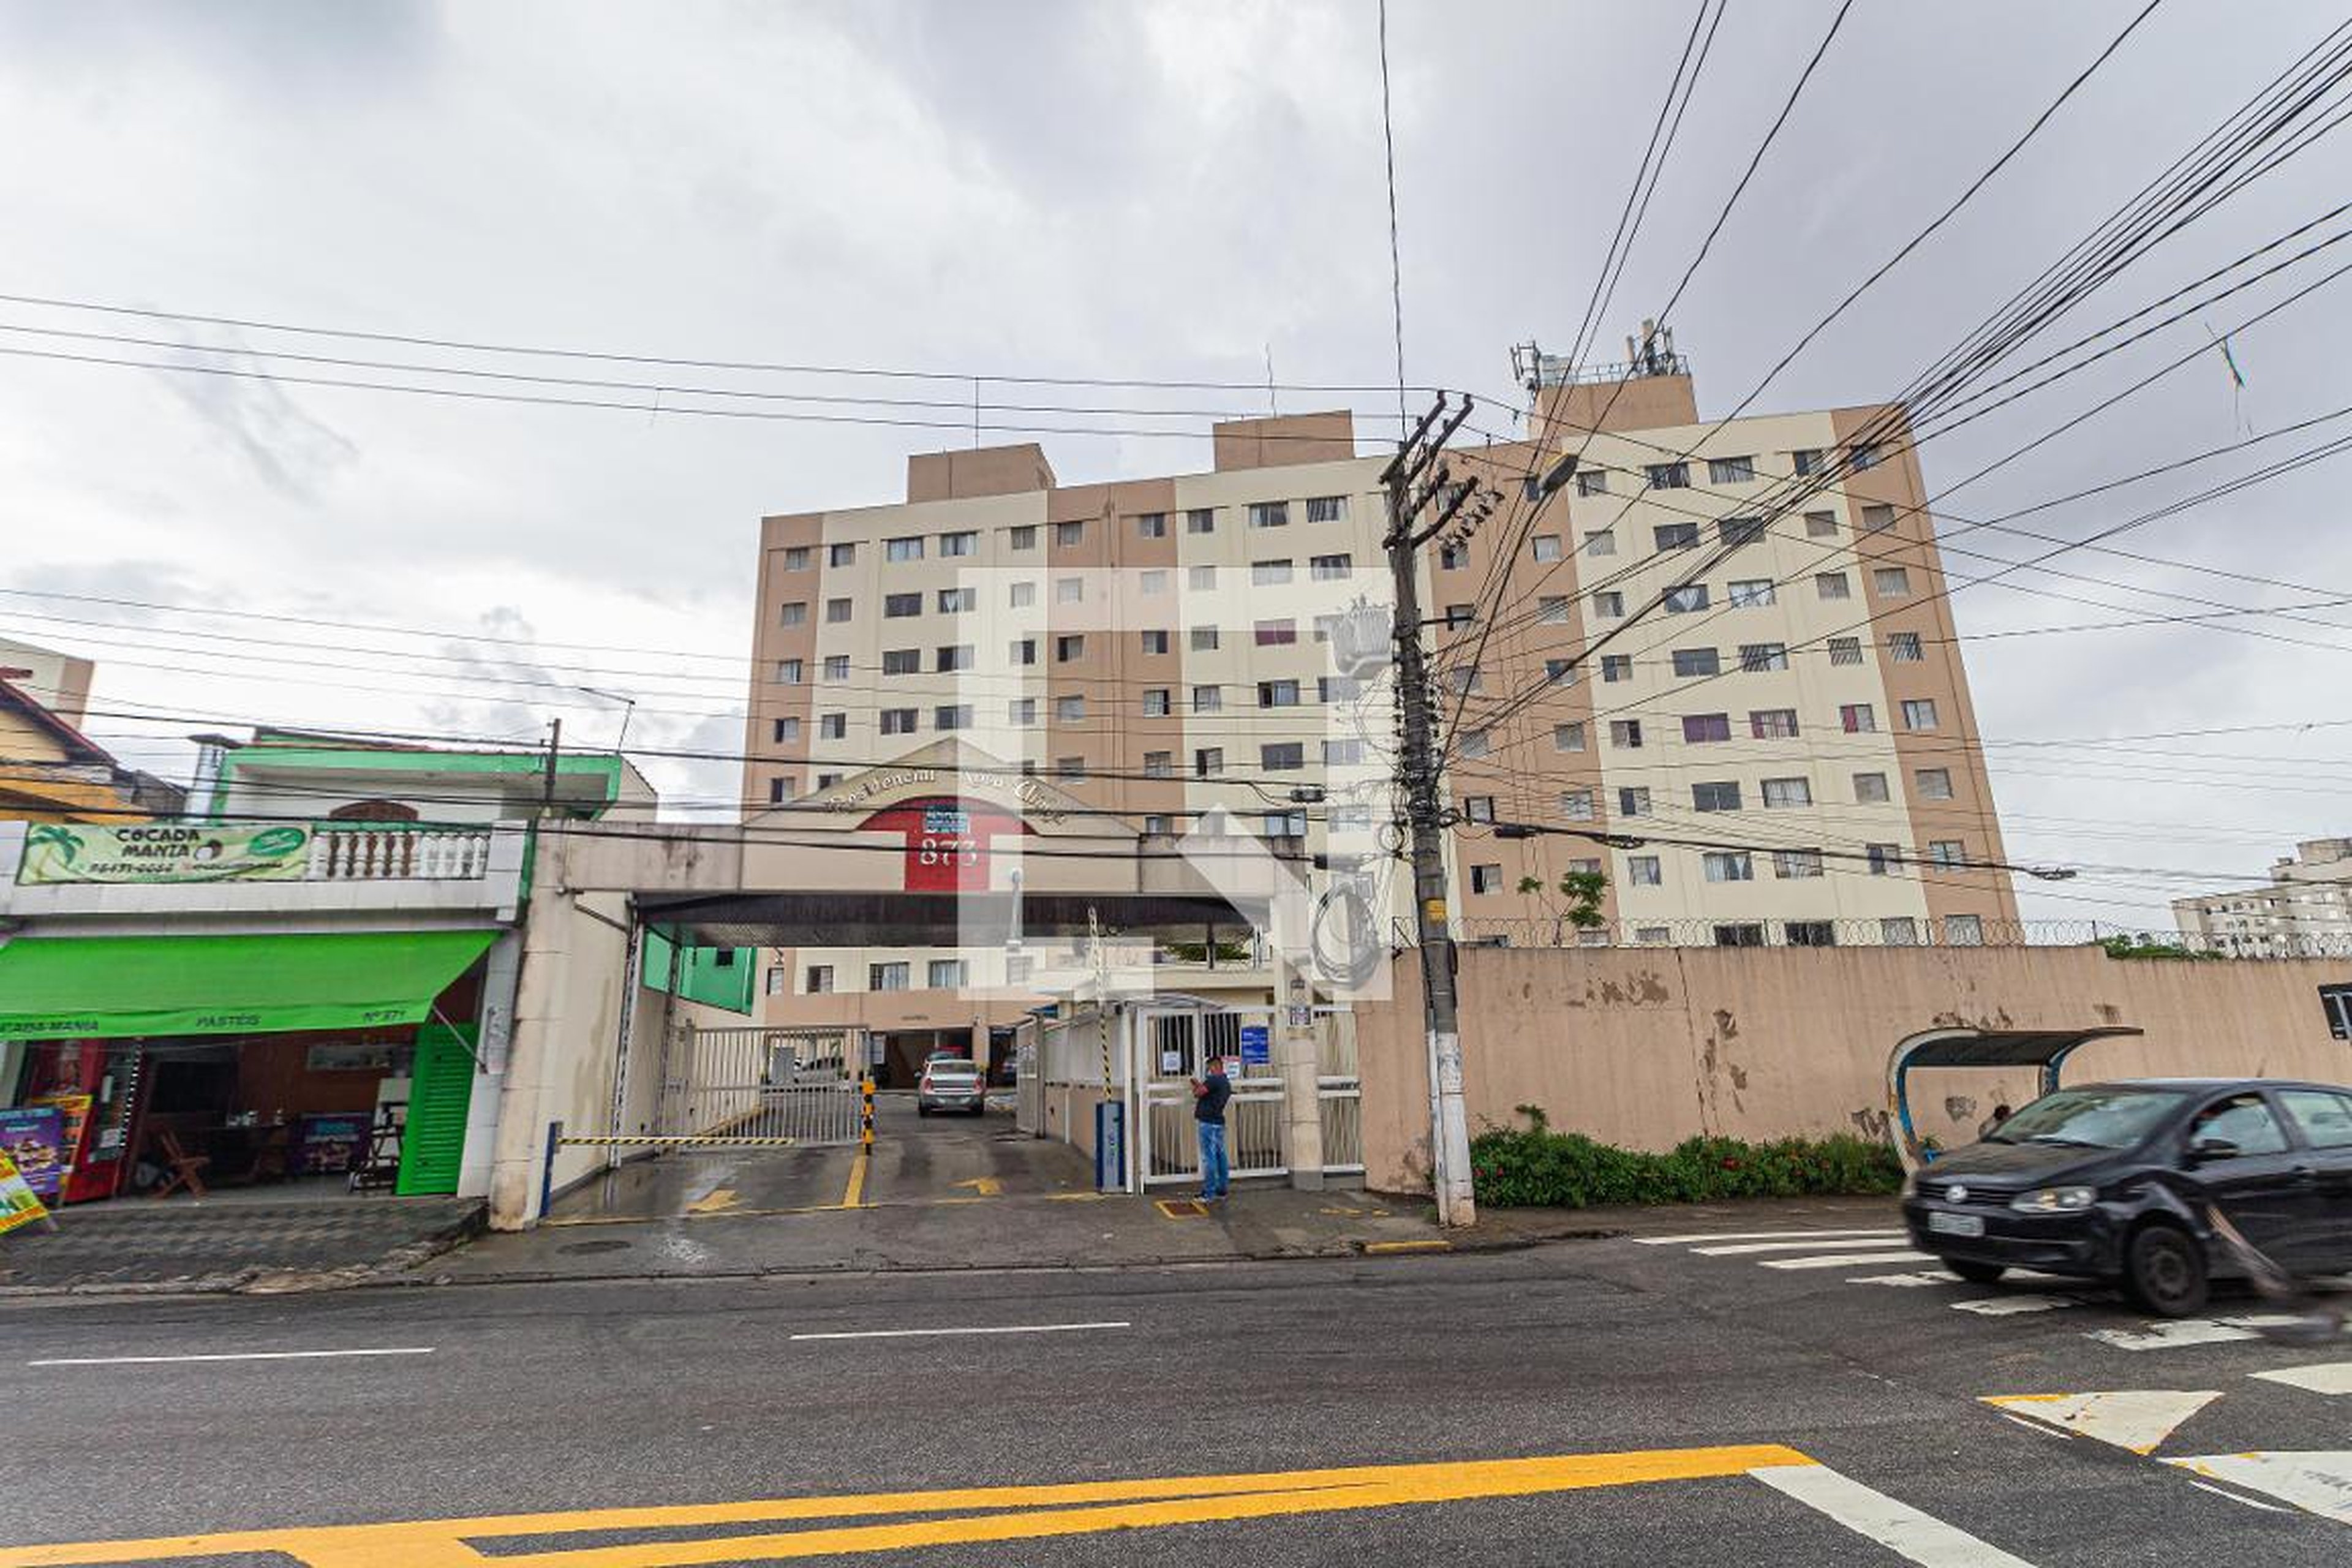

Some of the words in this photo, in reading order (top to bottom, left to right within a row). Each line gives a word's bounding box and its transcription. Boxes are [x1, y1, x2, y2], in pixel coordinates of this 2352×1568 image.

[116, 828, 200, 842] COCADA
[122, 843, 190, 858] MANIA
[920, 837, 978, 866] 873
